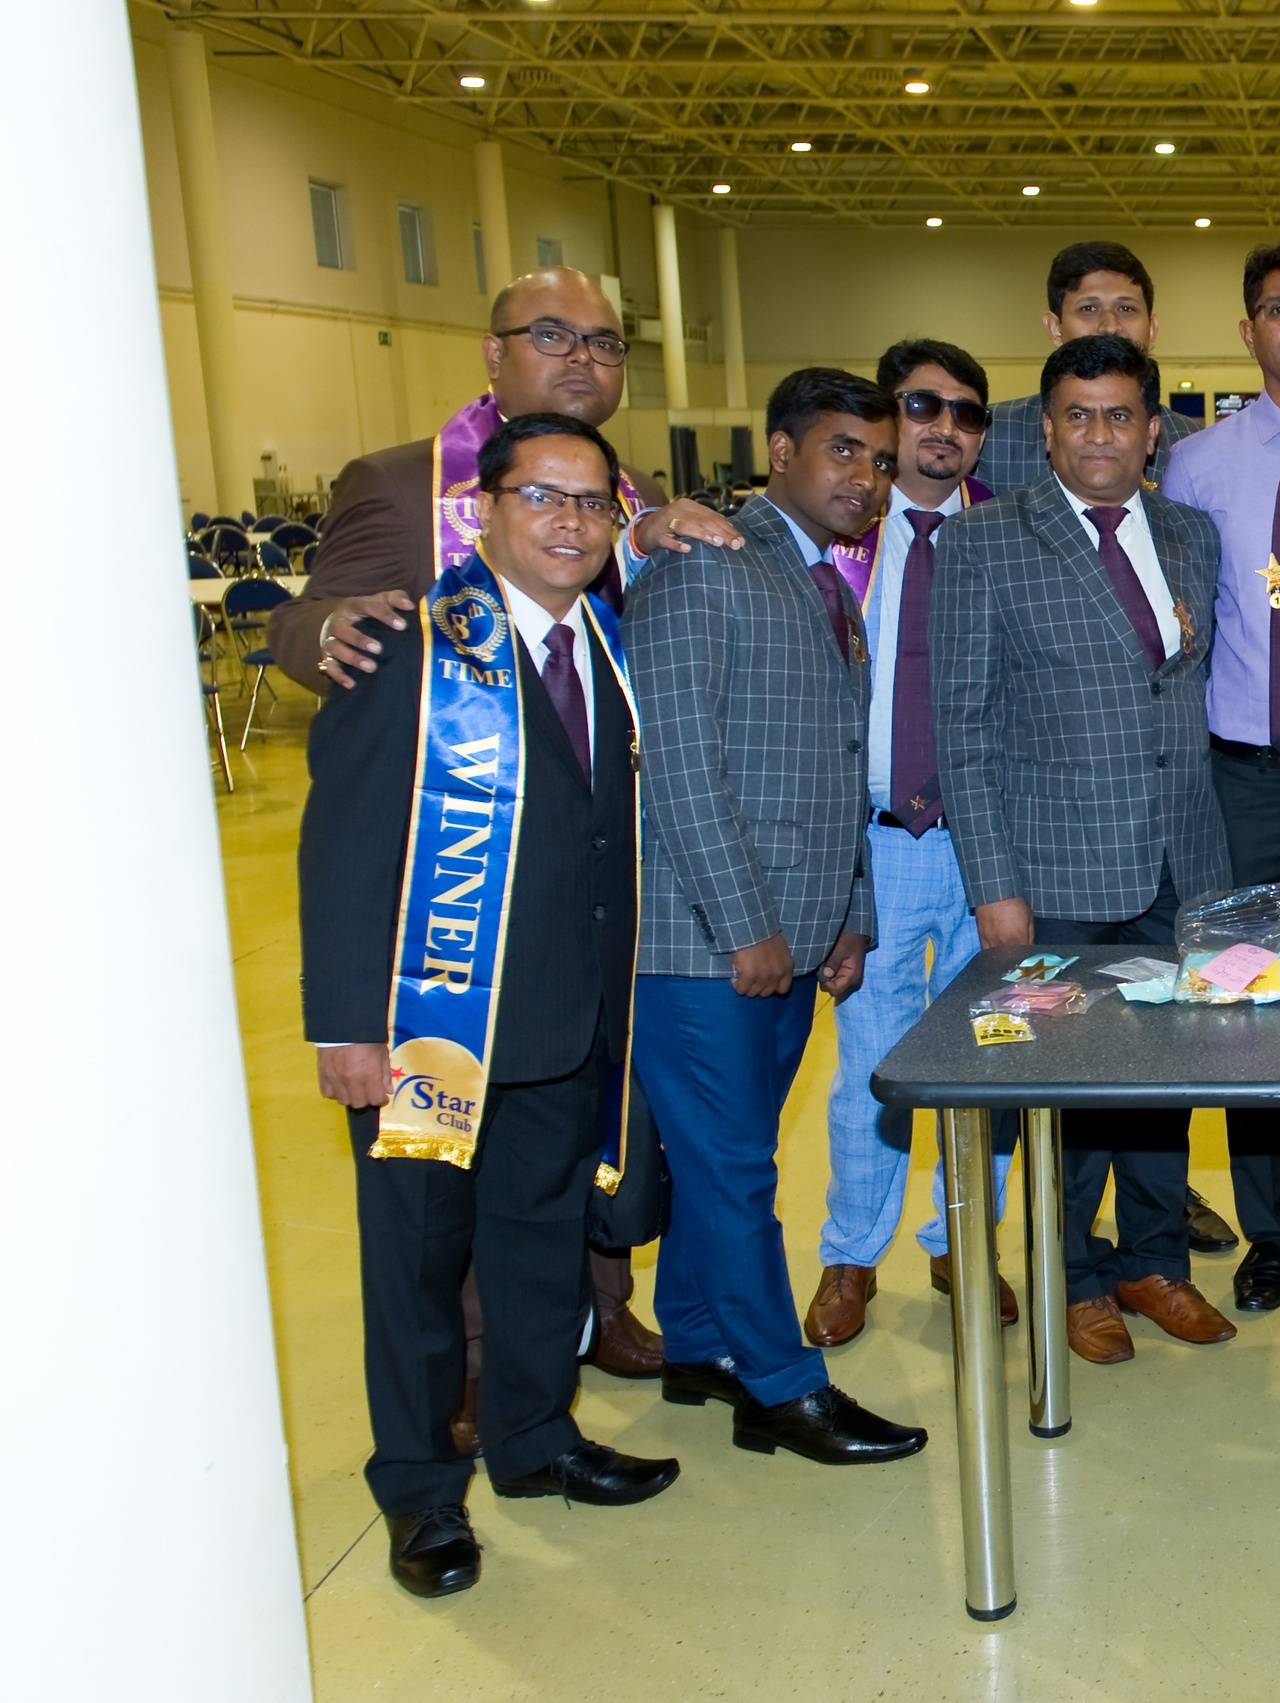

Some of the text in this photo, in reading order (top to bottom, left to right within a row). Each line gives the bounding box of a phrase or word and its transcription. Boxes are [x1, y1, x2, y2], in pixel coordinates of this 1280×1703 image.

[452, 602, 486, 640] 8th
[438, 658, 513, 689] TIME
[420, 732, 501, 997] WINNER
[410, 1080, 476, 1116] Star
[435, 1112, 472, 1133] Club
